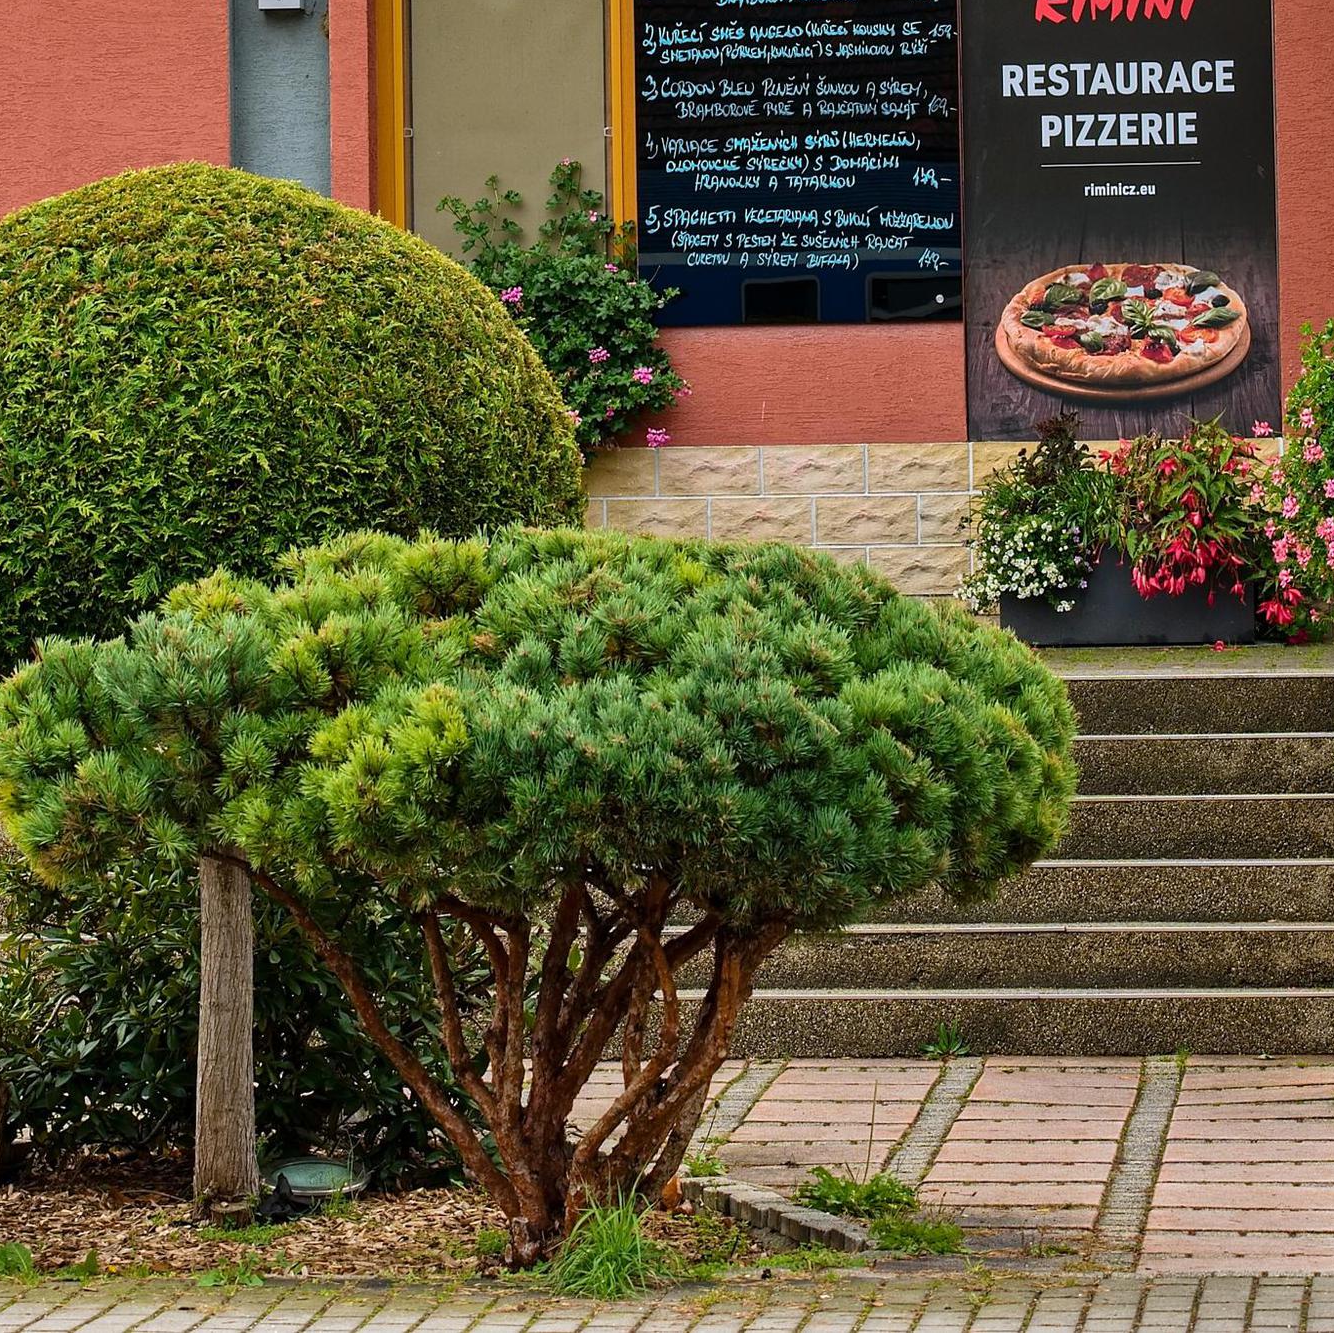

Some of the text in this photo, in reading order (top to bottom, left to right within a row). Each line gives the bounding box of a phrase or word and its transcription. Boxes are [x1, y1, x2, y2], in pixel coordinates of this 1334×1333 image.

[658, 22, 707, 47] KUŘECÍ
[1002, 60, 1235, 97] RESTAURACE
[719, 79, 754, 97] BLEU
[866, 81, 875, 99] A
[803, 102, 812, 118] A
[1041, 112, 1198, 148] PIZZERIE
[661, 136, 719, 159] VARIACE
[813, 155, 823, 171] S
[694, 173, 760, 192] HRANOLKY
[769, 175, 778, 192] A
[785, 175, 856, 193] TATARKOU
[1084, 182, 1156, 198] riminicz.eu
[663, 209, 736, 229] SPAGHETTI
[822, 210, 832, 227] S
[724, 233, 733, 248] S
[740, 253, 749, 268] A
[756, 248, 799, 268] SÝREM
